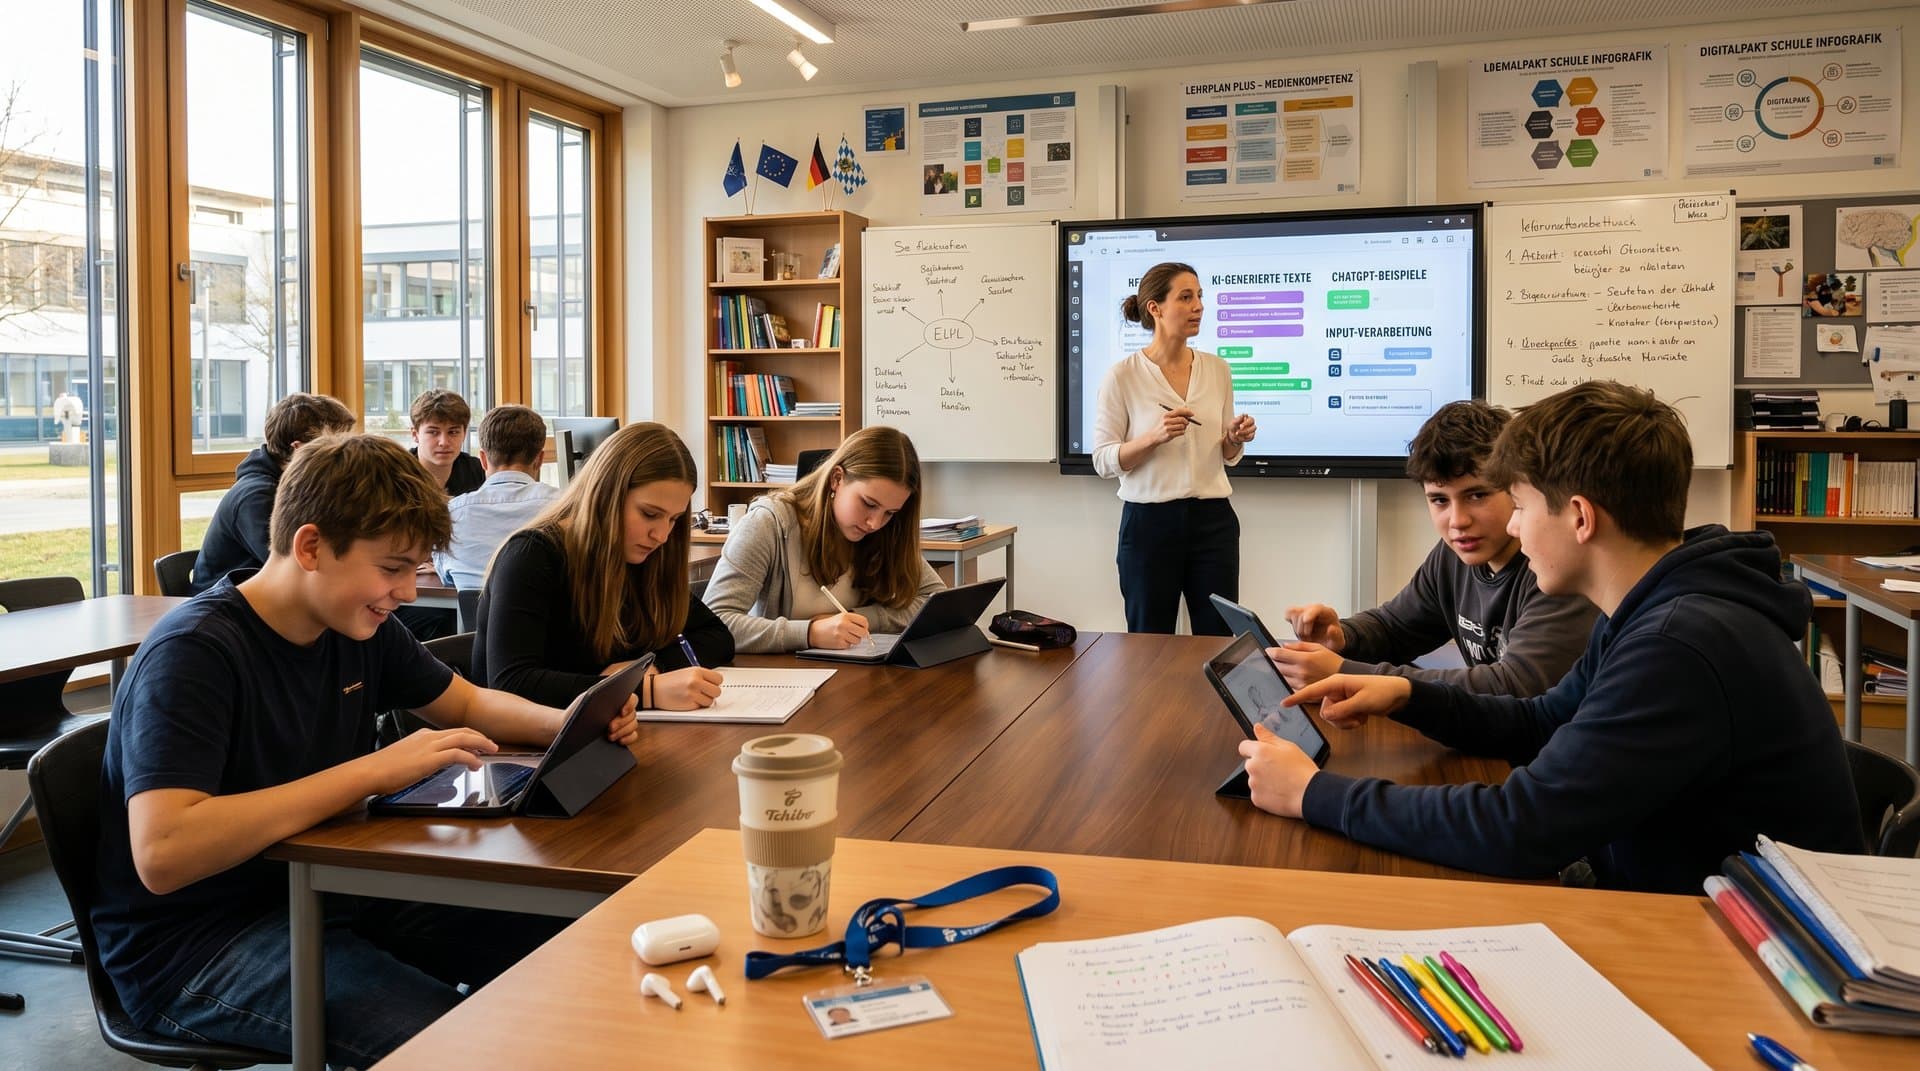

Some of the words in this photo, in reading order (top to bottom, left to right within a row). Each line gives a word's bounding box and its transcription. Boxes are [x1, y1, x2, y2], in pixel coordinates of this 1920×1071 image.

[1700, 42, 1768, 57] DIGITALPAKT
[1771, 38, 1813, 51] SCHULE
[1816, 33, 1882, 49] INFOGRAFIK
[1550, 55, 1589, 68] SCHULE
[1591, 50, 1652, 65] INFOGRAFIK
[1185, 83, 1231, 96] LEHRPLAN
[1233, 81, 1256, 92] PLUS
[1264, 73, 1354, 90] MEDIENKOMPETENZ
[1211, 273, 1281, 285] KI-GENERIERTE
[1283, 272, 1312, 283] TEXTE
[1332, 269, 1427, 282] CHATGPT-BEISPIELE
[1325, 326, 1432, 338] INPUT-VERARBEITUNG
[765, 808, 817, 822] Tchibo
